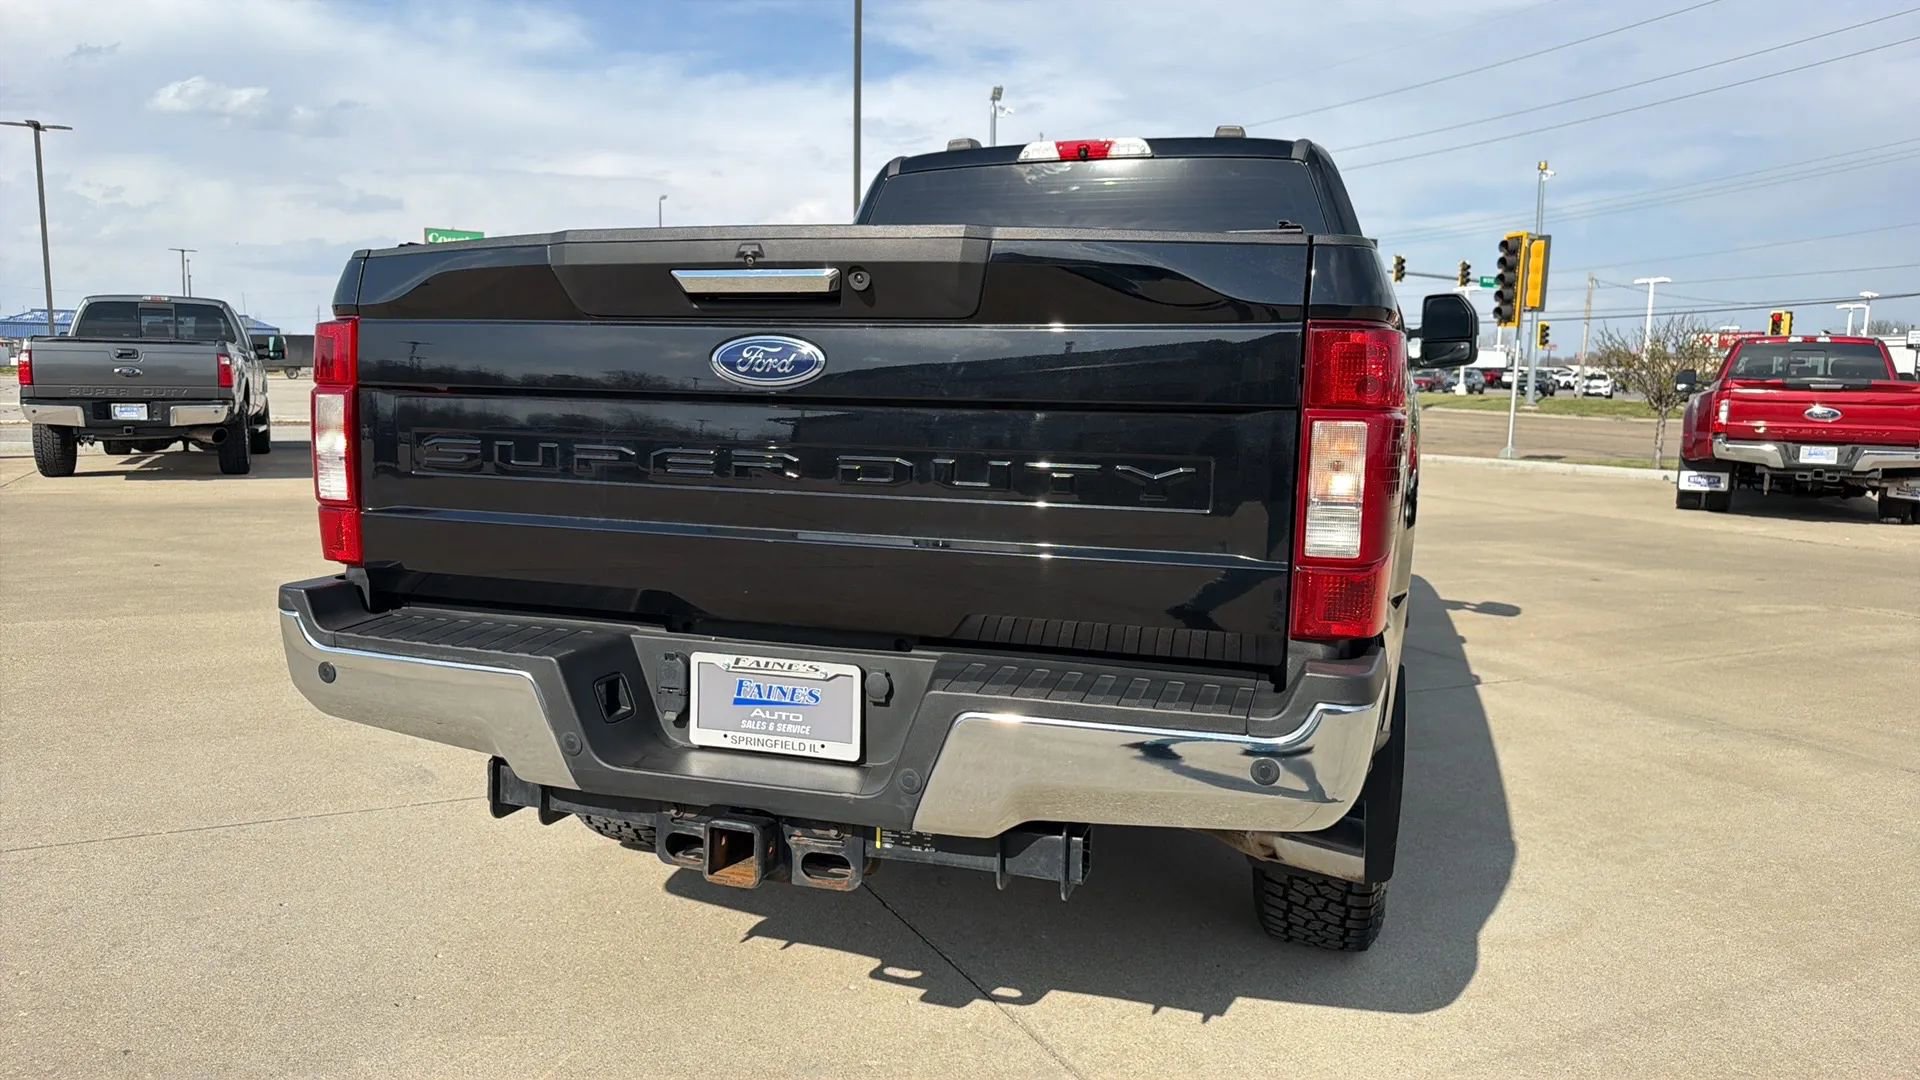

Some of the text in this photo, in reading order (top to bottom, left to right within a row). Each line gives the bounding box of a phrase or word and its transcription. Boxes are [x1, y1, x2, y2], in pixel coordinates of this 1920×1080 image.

[736, 345, 797, 373] Ford
[69, 388, 188, 397] SUPER DUTY
[422, 435, 1197, 501] SUPER DUTY
[732, 656, 820, 673] FAINE'S
[734, 677, 822, 705] FAINE'S
[750, 707, 803, 722] AUTO
[740, 719, 767, 731] SALES
[776, 723, 811, 735] SERVICE
[730, 735, 820, 753] SPRINGFIELD IL
